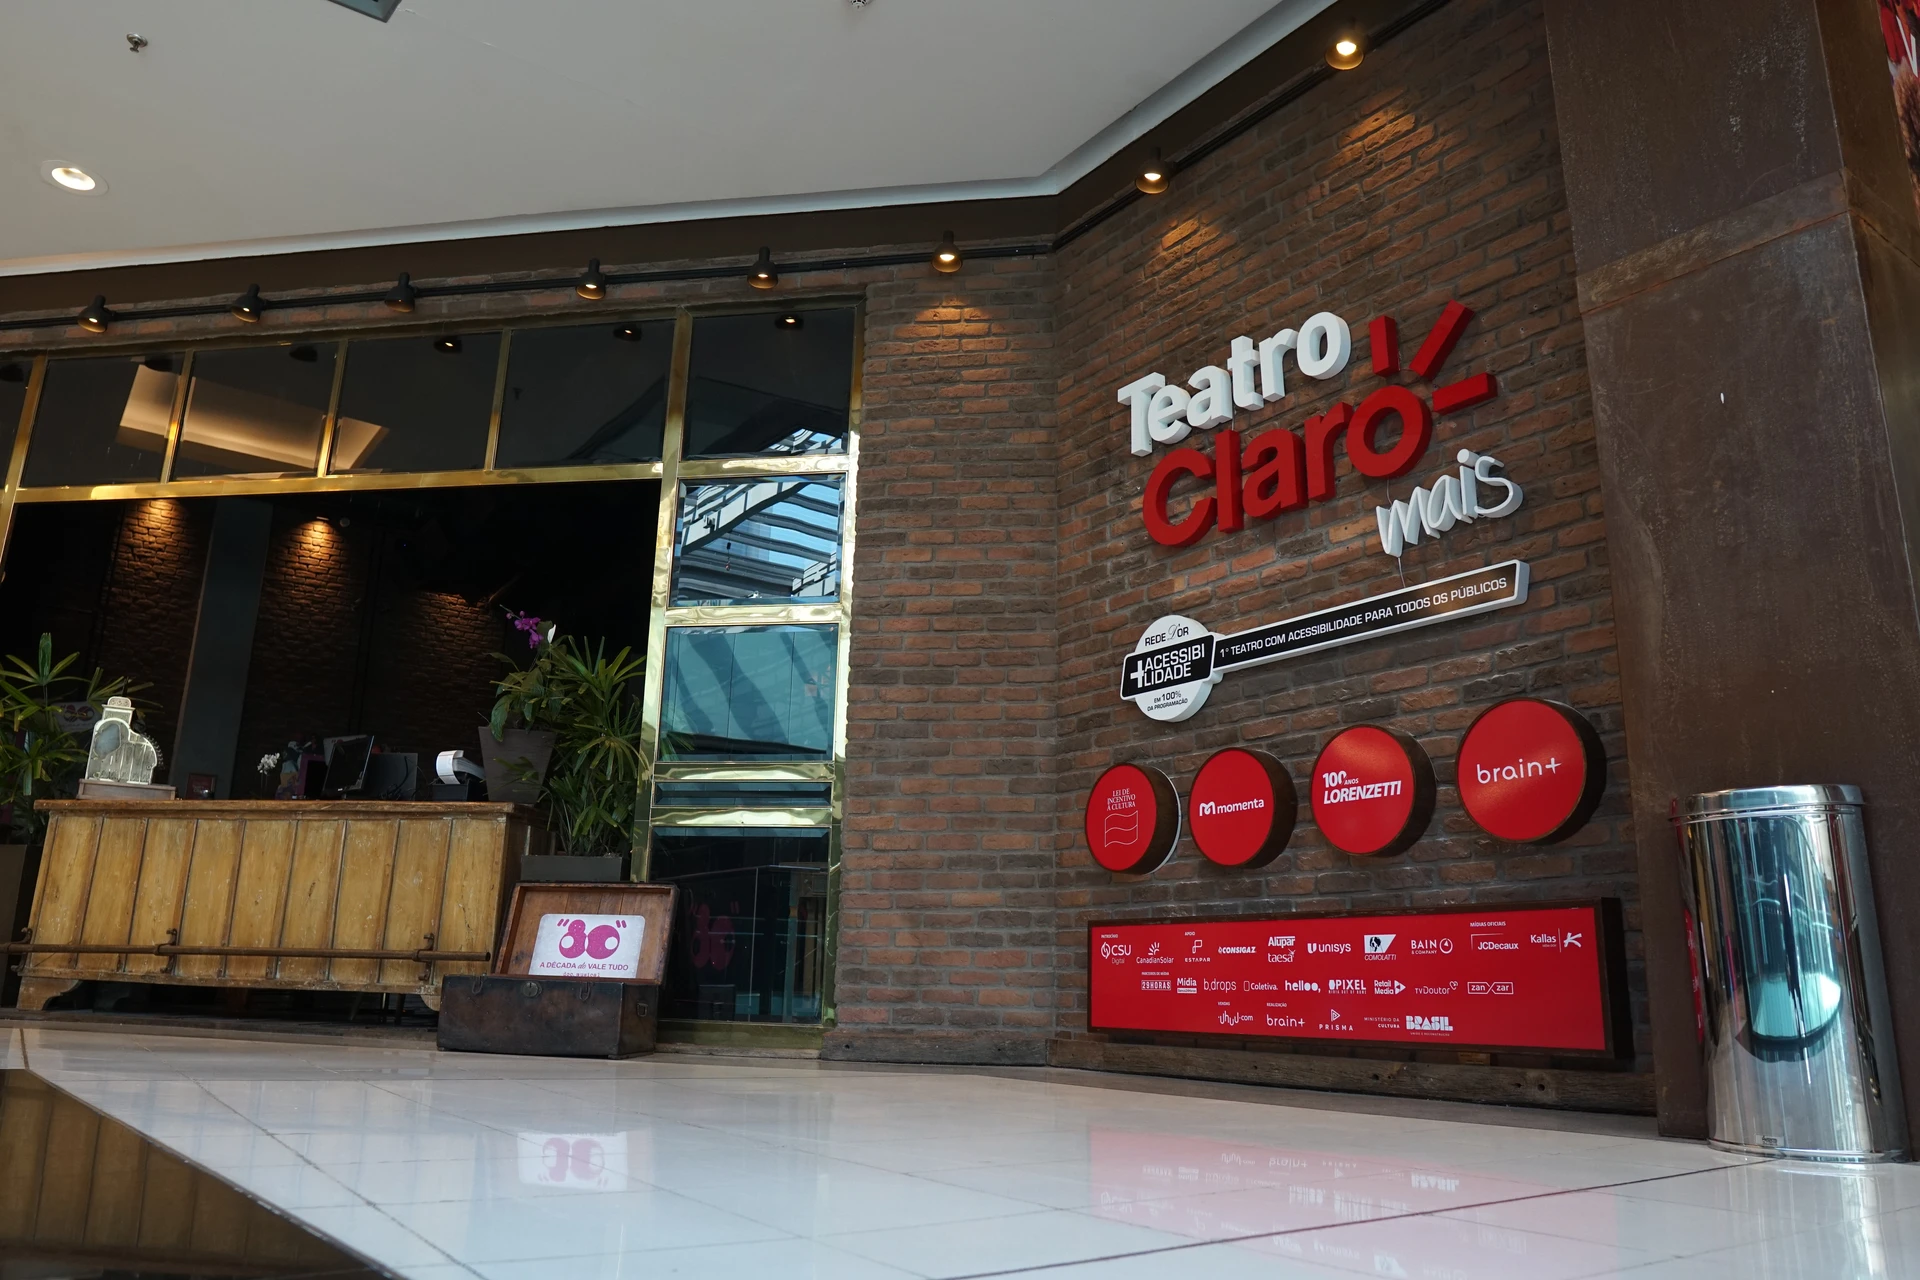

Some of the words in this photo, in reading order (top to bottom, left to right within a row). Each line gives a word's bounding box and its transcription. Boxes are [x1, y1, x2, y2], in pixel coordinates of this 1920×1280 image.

[1117, 311, 1351, 457] Teatro
[1143, 385, 1432, 547] Claro
[1376, 448, 1523, 557] mais
[1230, 639, 1264, 656] TEATRO
[1265, 634, 1286, 648] COM
[1287, 613, 1363, 643] ACESSIBILIDADE
[1365, 607, 1393, 623] PARA
[1394, 597, 1431, 615] TODOS
[1432, 592, 1448, 606] OS
[1450, 577, 1507, 602] PÚBLICOS
[1144, 632, 1166, 647] REDE
[1144, 643, 1205, 671] ACESSIBI
[1144, 661, 1192, 687] LIDADE
[1153, 696, 1161, 704] EM
[1161, 690, 1182, 701] 100%
[1154, 697, 1188, 711] PROGRAMAÇÃO
[1476, 757, 1562, 784] brain+
[1322, 770, 1347, 788] 100
[1343, 777, 1359, 785] ANOS
[1122, 788, 1130, 796] DE
[1323, 780, 1402, 805] LORENZETTI
[1107, 794, 1136, 805] INCENTIVO
[1112, 801, 1136, 810] CULTURA
[1217, 798, 1265, 814] momenta
[1267, 935, 1296, 949] Alupar
[1410, 940, 1437, 950] BAIN
[1477, 941, 1519, 950] JCDecaux
[1530, 934, 1557, 944] Kallas
[1111, 944, 1132, 956] CSU
[1222, 946, 1257, 954] CONSIGAZ
[1111, 957, 1125, 966] Digital
[1267, 952, 1294, 963] taesa
[546, 961, 577, 969] DÉCADA
[588, 963, 606, 971] VALE
[608, 963, 629, 971] TUDO
[1374, 987, 1394, 995] Media
[1266, 1014, 1305, 1027] brain+
[1319, 1023, 1354, 1031] PRISMA
[1405, 1015, 1454, 1031] BRASIL
